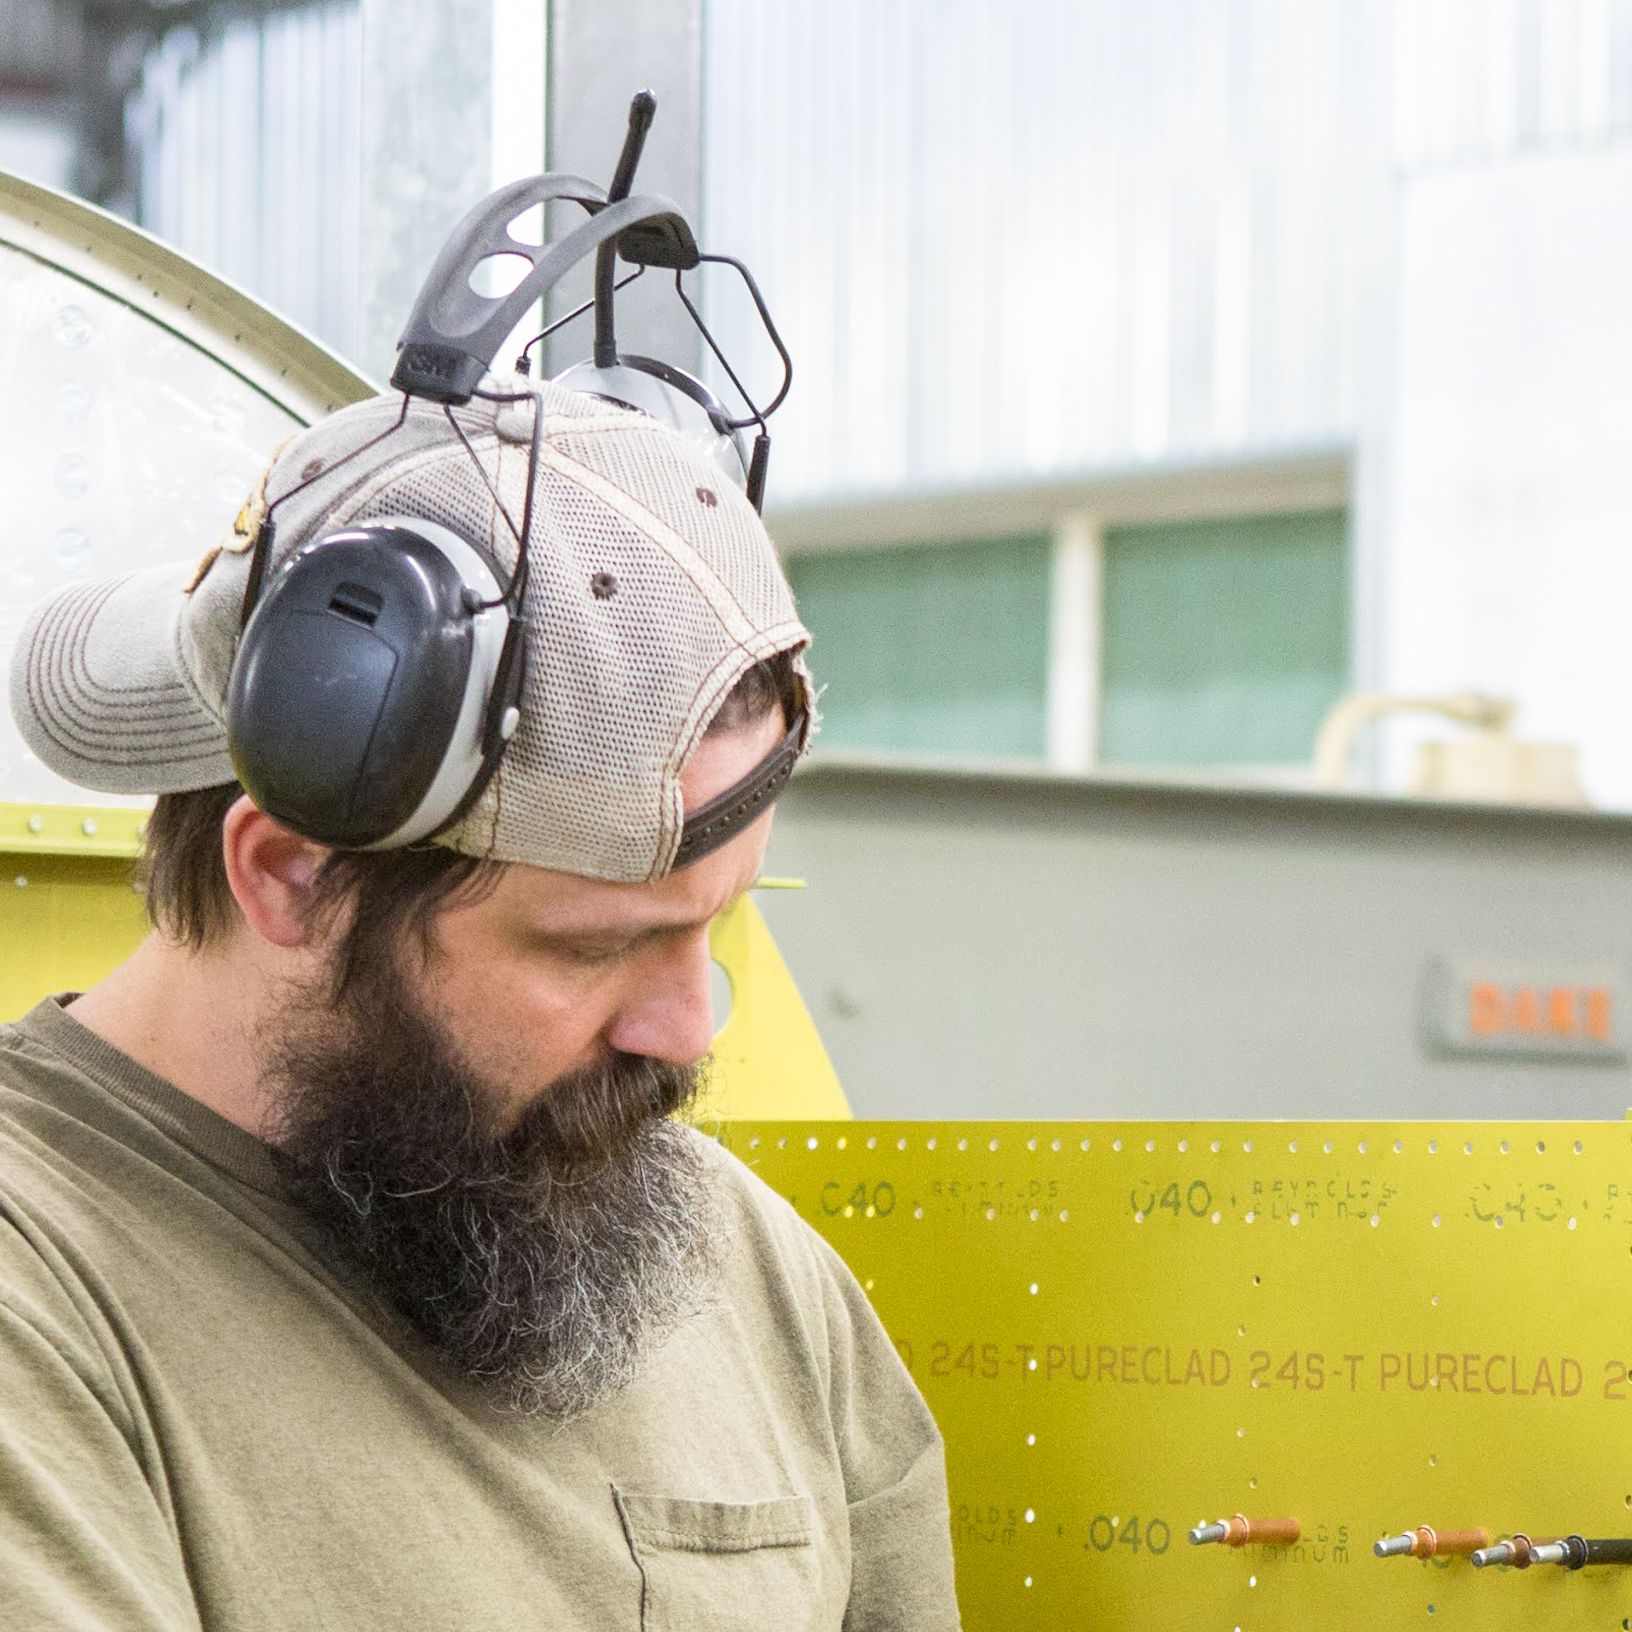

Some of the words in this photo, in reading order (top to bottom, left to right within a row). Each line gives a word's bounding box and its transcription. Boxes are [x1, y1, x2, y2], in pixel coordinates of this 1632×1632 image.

[1045, 1344, 1232, 1388] PURECLAD
[1249, 1349, 1365, 1393] 24S-T
[1378, 1352, 1583, 1399] PURECLAD
[1082, 1514, 1171, 1556] .040
